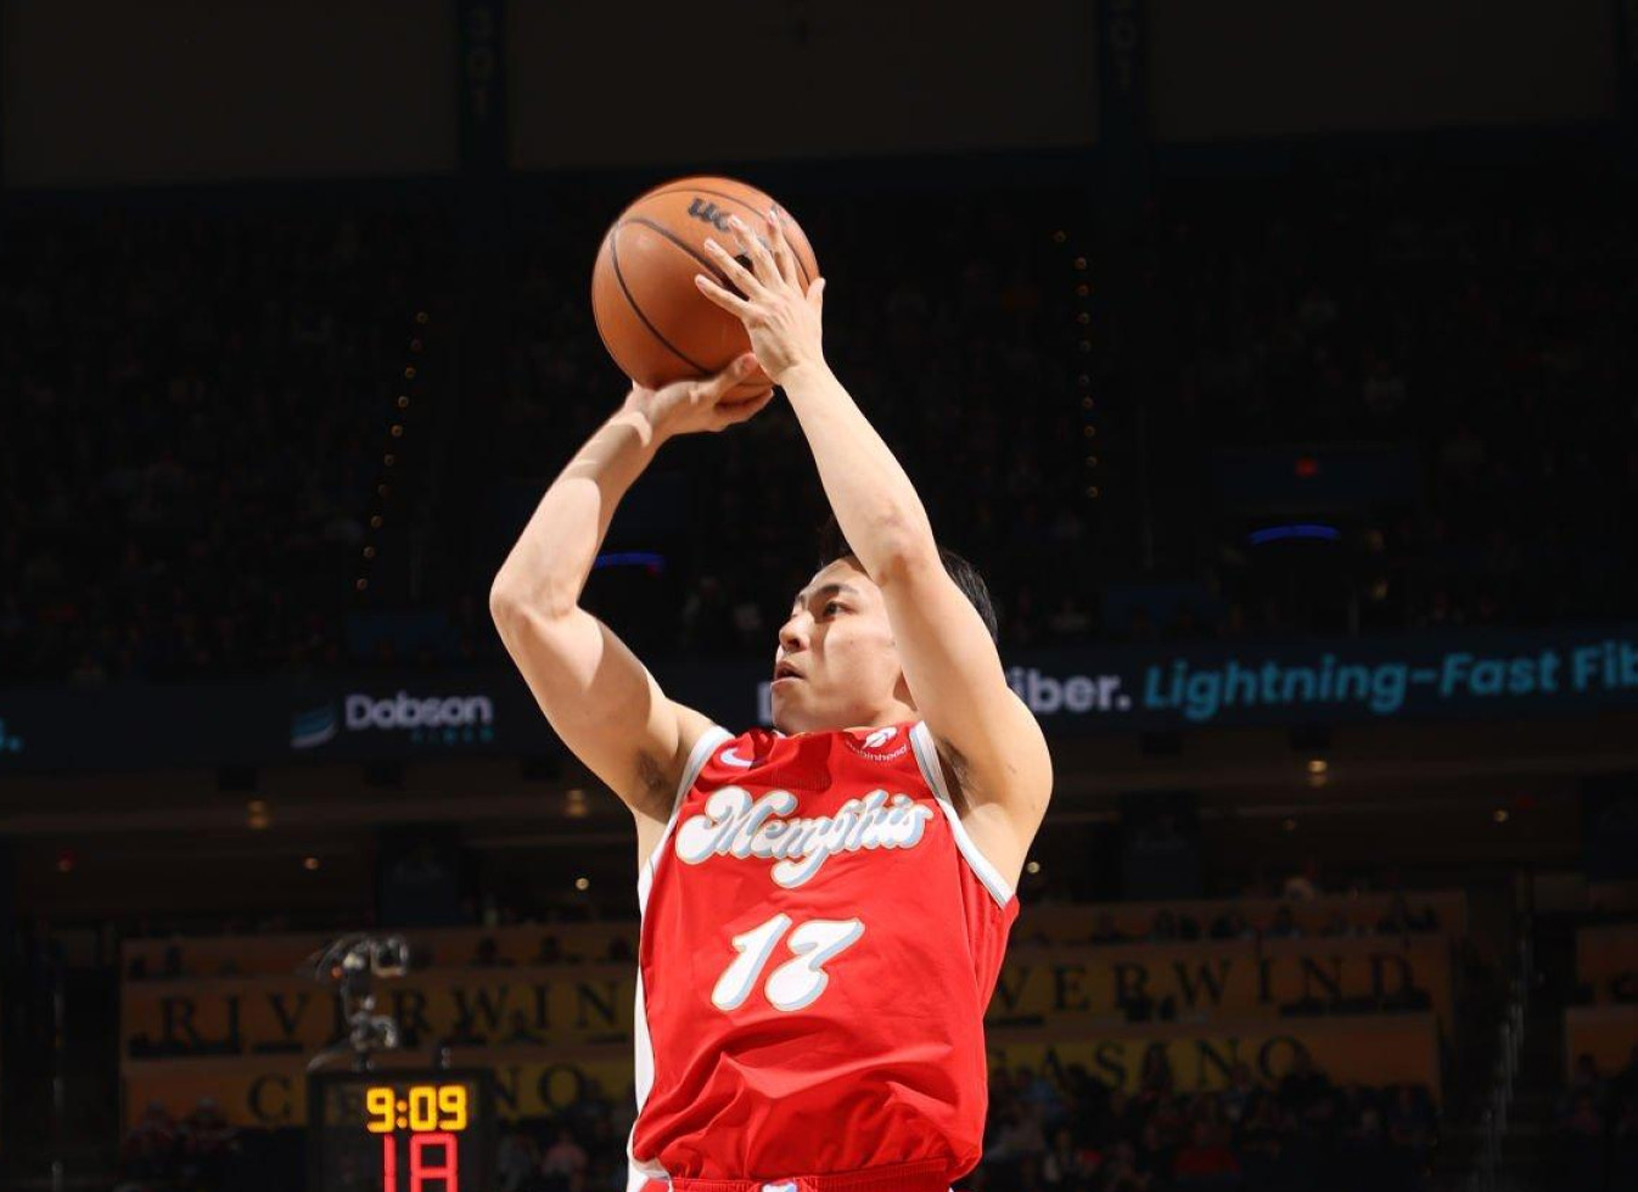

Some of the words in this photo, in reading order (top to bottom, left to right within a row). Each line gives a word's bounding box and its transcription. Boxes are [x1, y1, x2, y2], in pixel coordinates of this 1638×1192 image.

[344, 689, 494, 731] Dobson
[1008, 664, 1133, 714] iber.
[1143, 648, 1562, 722] Lightning-Fast
[675, 785, 934, 888] Memphis
[366, 1084, 468, 1133] 9:09
